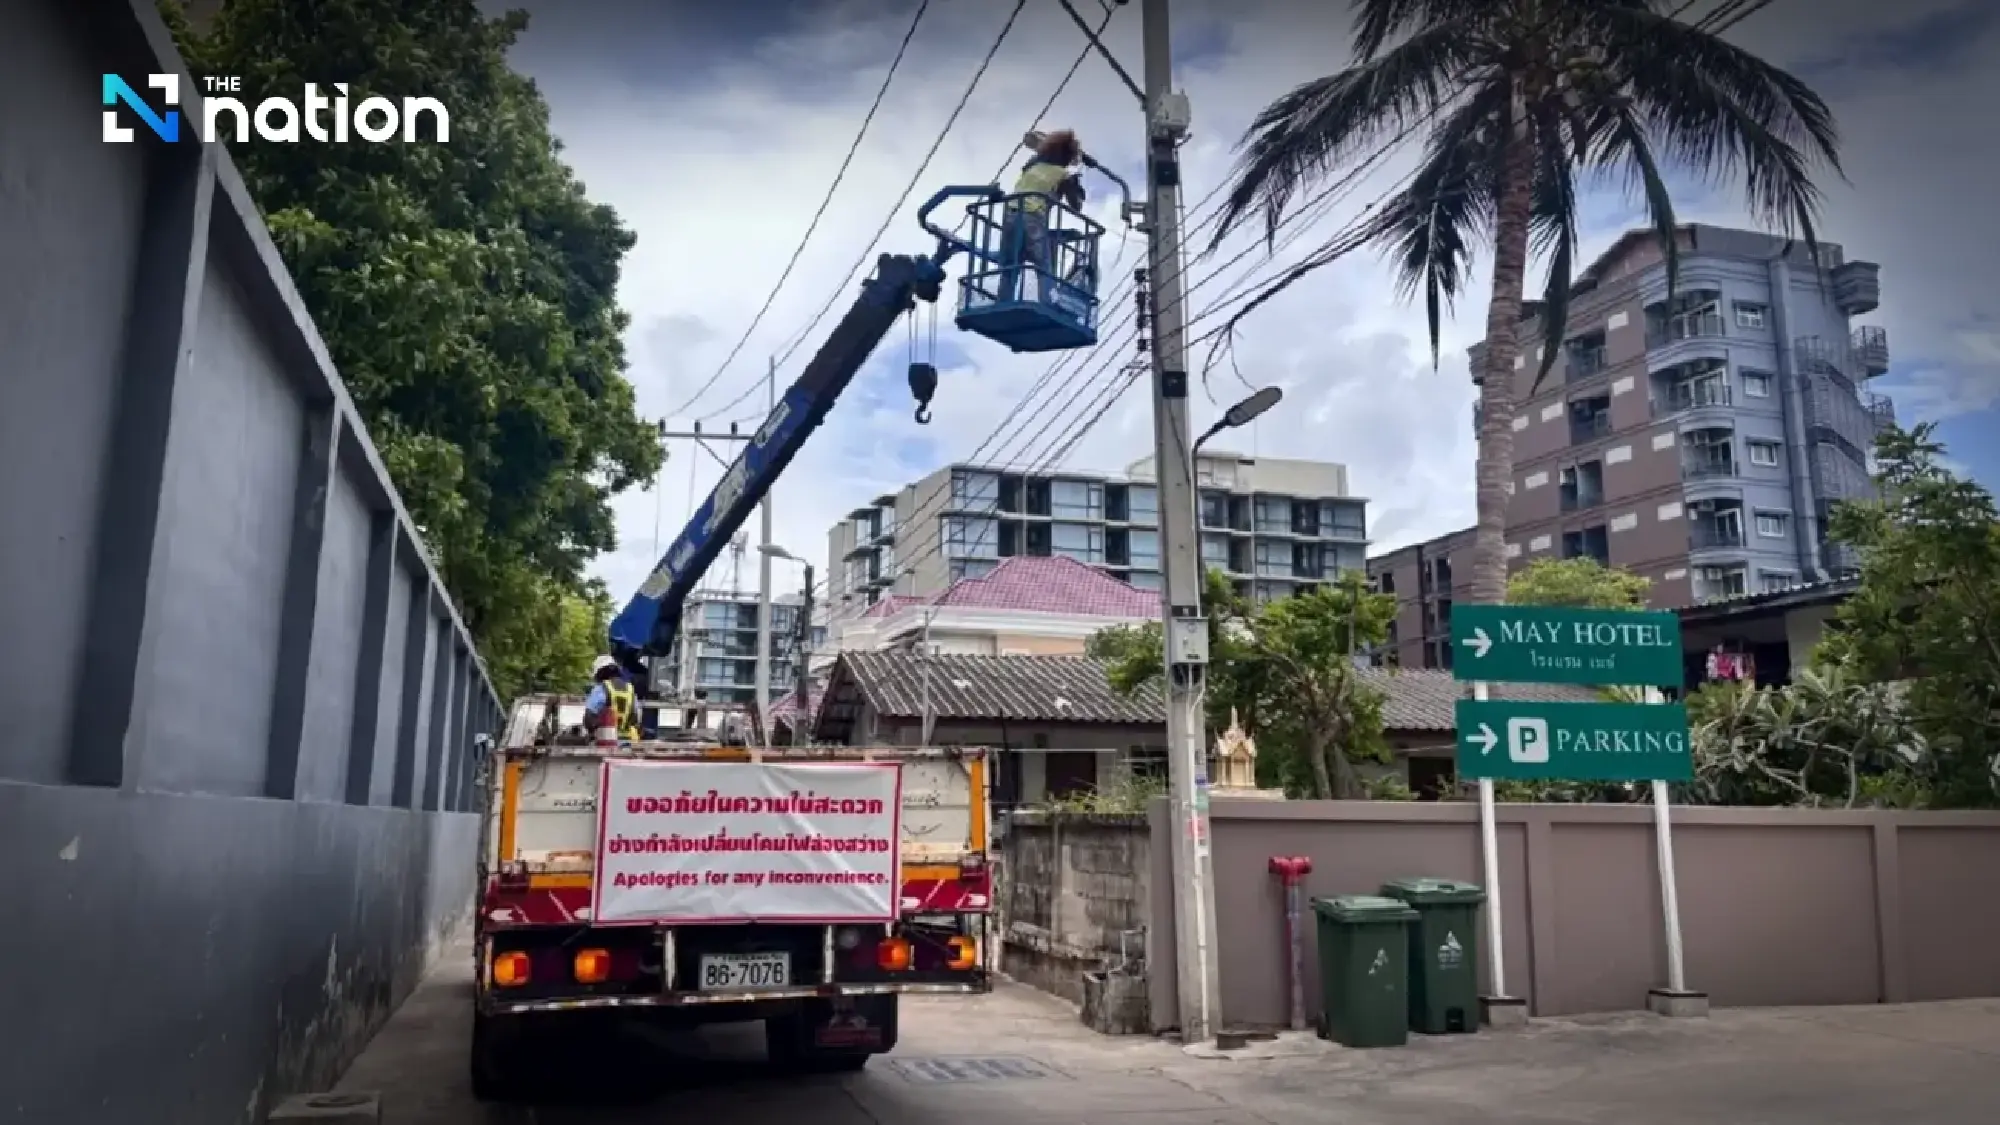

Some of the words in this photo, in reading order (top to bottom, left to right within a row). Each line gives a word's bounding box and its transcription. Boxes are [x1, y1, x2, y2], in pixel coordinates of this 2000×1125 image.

[1500, 620, 1562, 644] MAY
[1574, 622, 1672, 647] HOTEL
[1519, 726, 1538, 753] P
[1556, 728, 1683, 753] PARKING
[626, 790, 883, 814] ขออภัยในความไม่สะดวก
[614, 871, 698, 889] Apologies
[705, 871, 729, 884] for
[734, 873, 765, 888] any
[768, 871, 889, 885] inconvenience.
